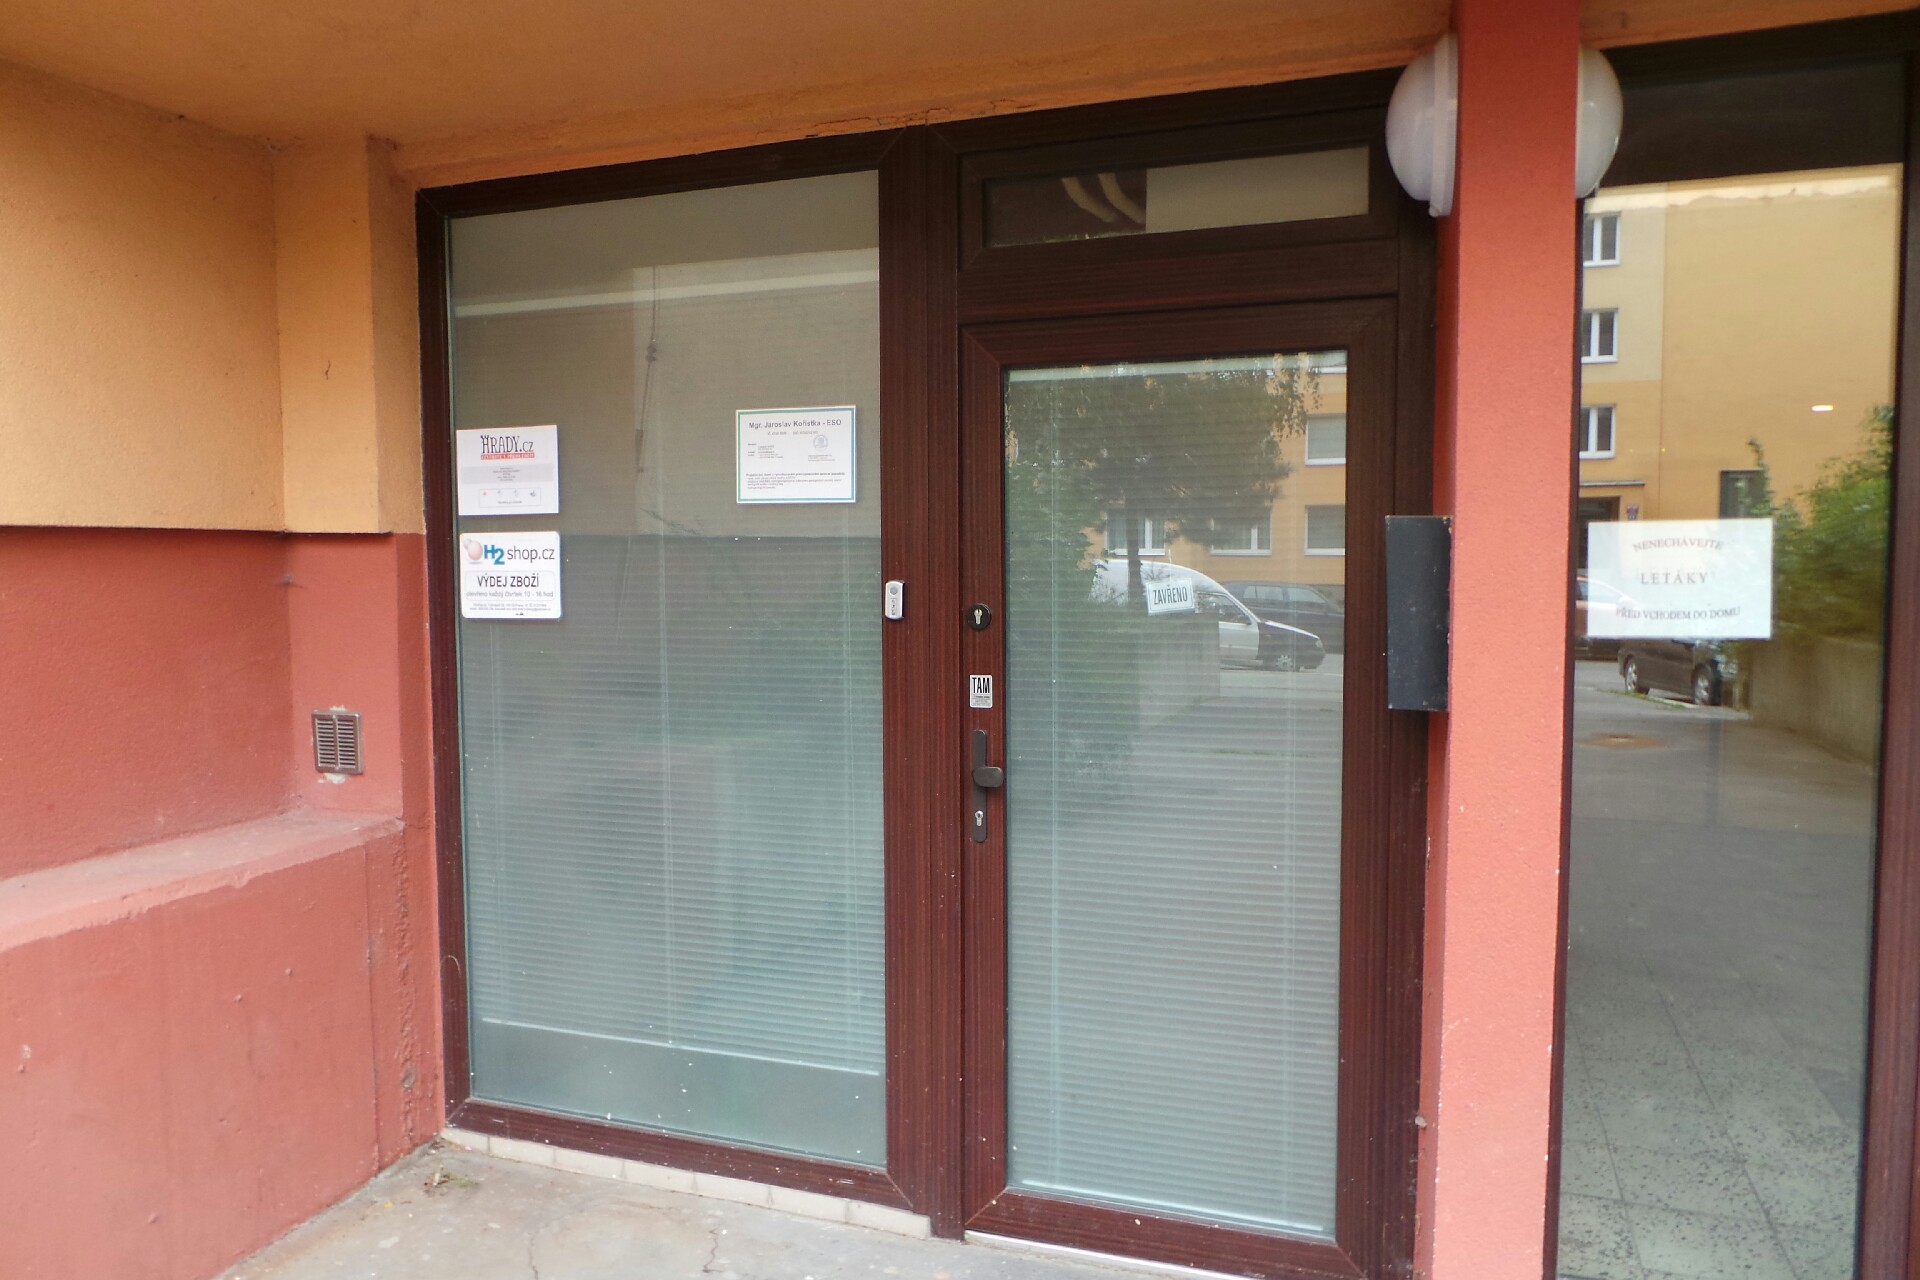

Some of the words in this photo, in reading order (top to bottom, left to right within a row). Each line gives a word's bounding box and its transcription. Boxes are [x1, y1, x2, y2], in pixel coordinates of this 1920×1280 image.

[749, 422, 763, 430] Mgr.
[793, 419, 821, 427] Kořistka
[1633, 536, 1725, 553] NENECHÁVEJTE
[477, 573, 508, 588] VÝDEJ
[510, 572, 539, 588] ZBOŽÍ
[1640, 569, 1709, 586] LETÁKY
[488, 589, 504, 599] každý
[504, 589, 522, 598] čtvrtek
[1153, 584, 1188, 605] ZAVŘENO
[1616, 606, 1640, 619] PŘED
[1643, 609, 1691, 620] VCHODEM
[1693, 609, 1707, 620] DO
[972, 677, 990, 693] TAM
